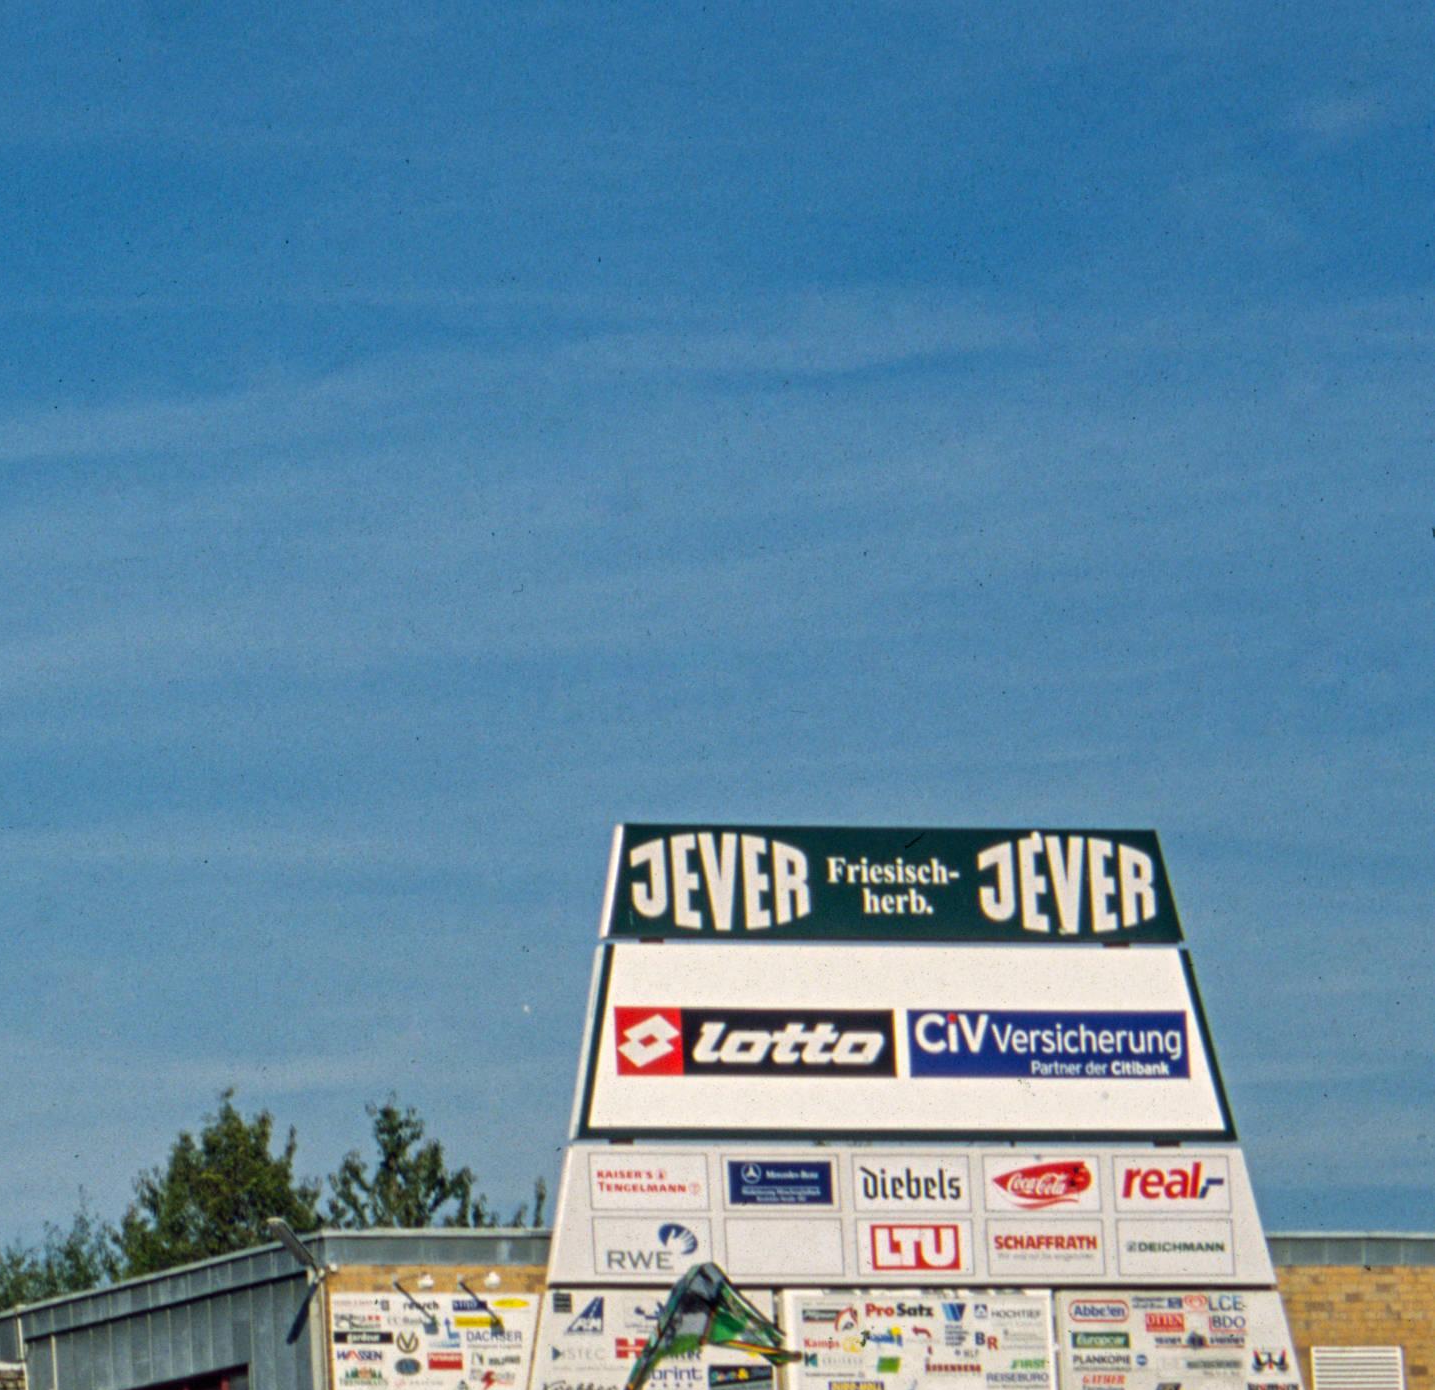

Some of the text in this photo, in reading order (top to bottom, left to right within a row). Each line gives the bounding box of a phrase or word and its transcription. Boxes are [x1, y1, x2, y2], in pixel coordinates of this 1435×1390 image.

[630, 832, 1156, 935] JEVER Friesisch- JEVER
[863, 886, 935, 916] herb.
[991, 1023, 1183, 1061] Versicherung
[1030, 1060, 1170, 1077] Partner der Citibank
[596, 1169, 654, 1181] KAISER'S
[597, 1181, 687, 1194] TENGELMANN
[875, 1226, 957, 1268] LTU
[994, 1235, 1098, 1250] SCHAFFRATH
[1139, 1241, 1226, 1253] DEICHMANN
[606, 1249, 674, 1271] RWE
[1212, 1315, 1247, 1329] BDO
